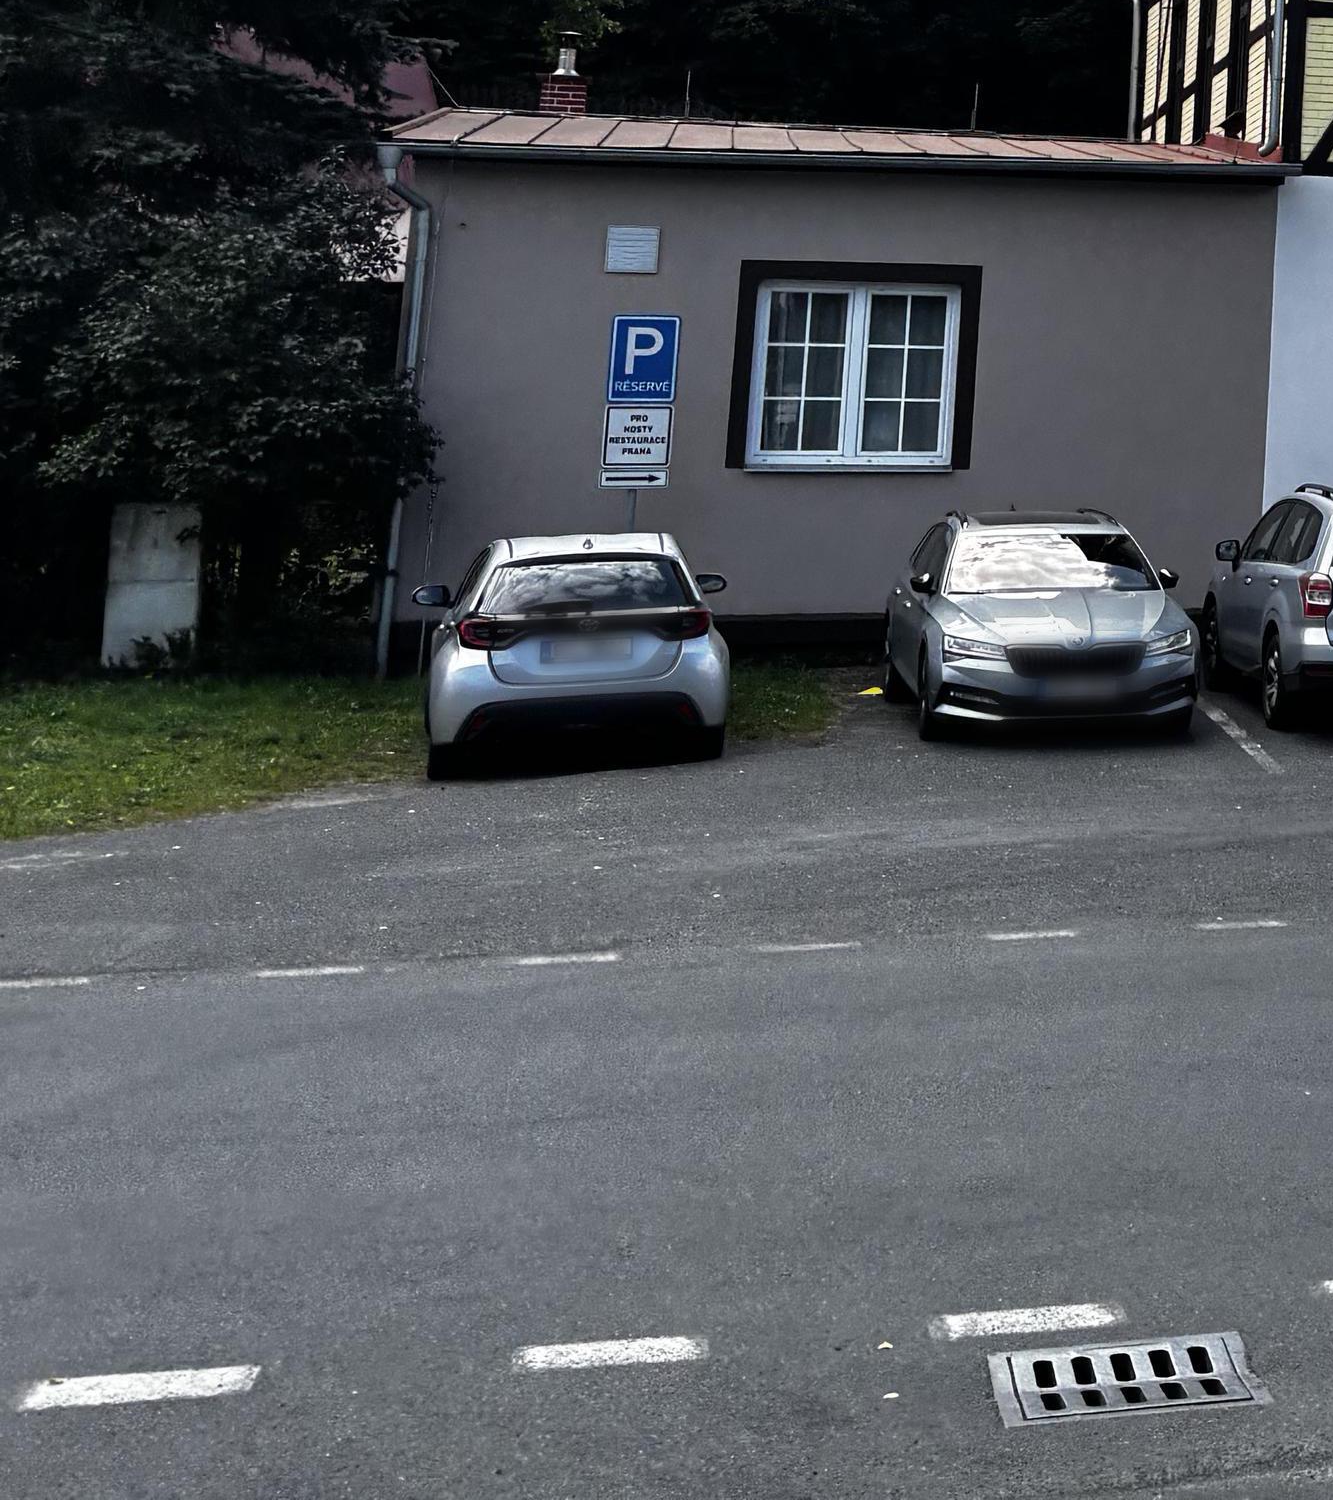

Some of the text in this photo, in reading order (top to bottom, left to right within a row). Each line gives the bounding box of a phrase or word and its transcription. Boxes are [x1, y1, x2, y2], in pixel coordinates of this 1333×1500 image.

[624, 326, 664, 375] P
[630, 414, 649, 423] PRO
[608, 436, 667, 444] RESTAURACE
[621, 447, 652, 455] PRAHA
